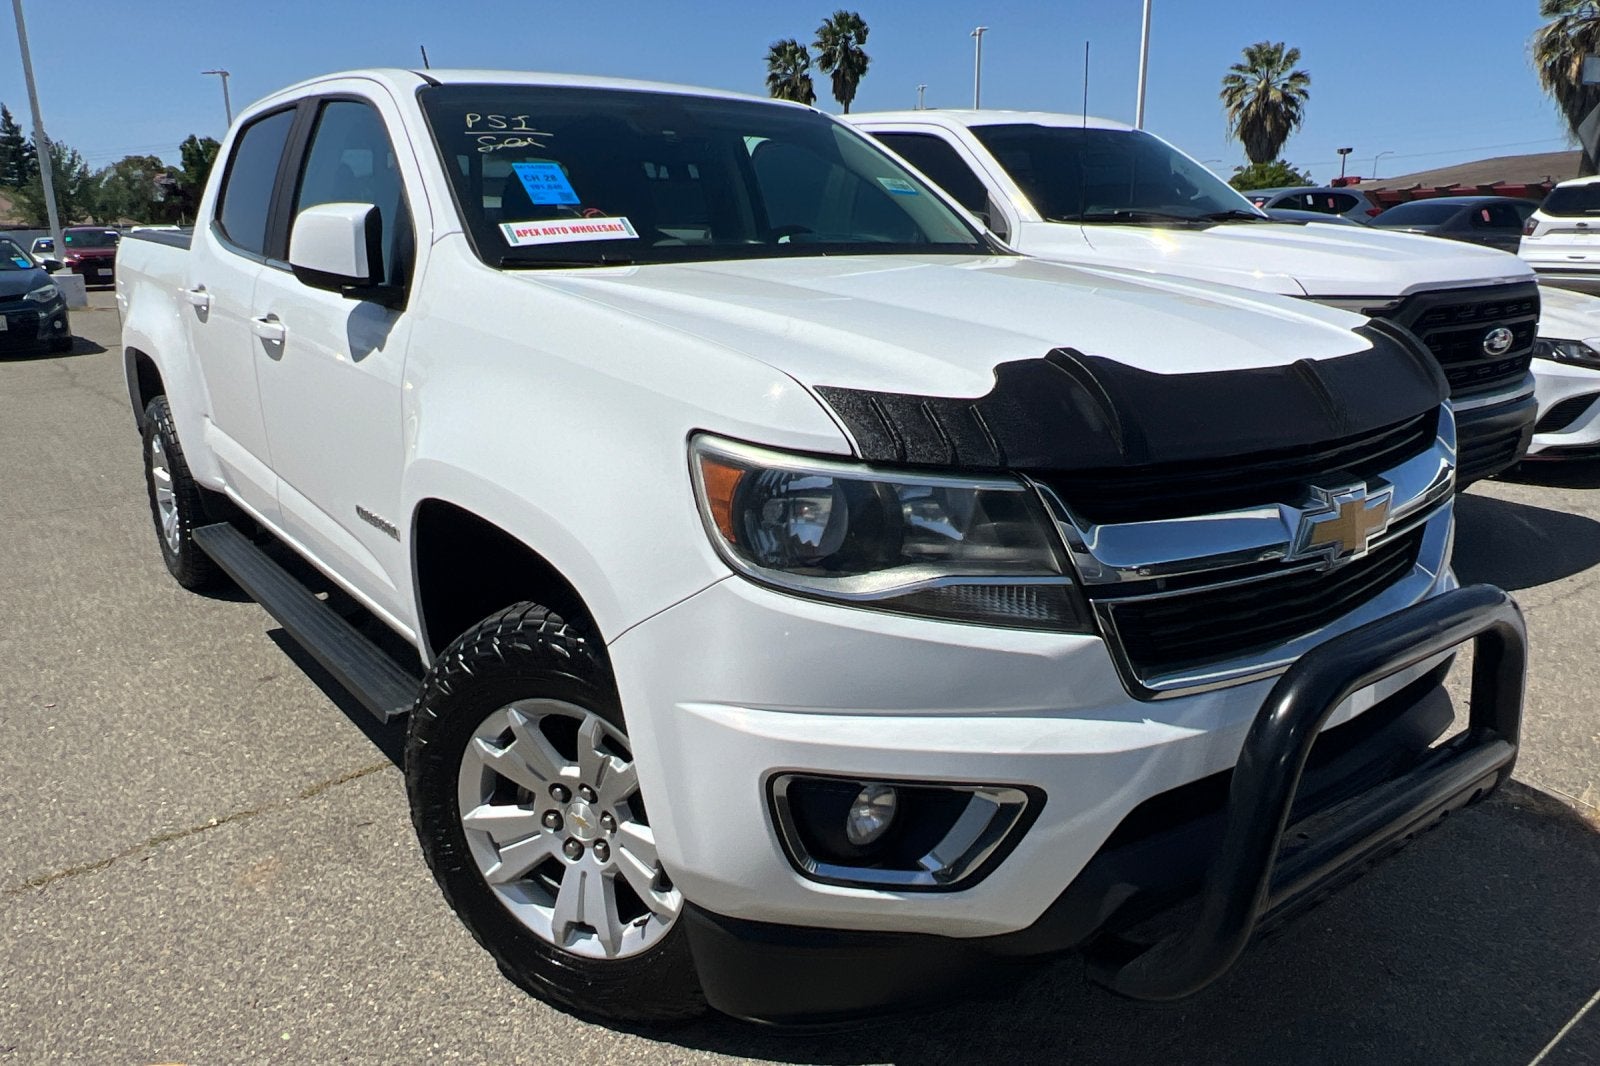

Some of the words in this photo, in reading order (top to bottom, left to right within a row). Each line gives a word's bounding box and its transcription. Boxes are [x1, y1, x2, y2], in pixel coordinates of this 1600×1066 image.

[466, 113, 536, 130] PSI
[515, 228, 542, 237] APEX
[542, 226, 569, 235] AUTO
[570, 224, 625, 233] WHOLESALE
